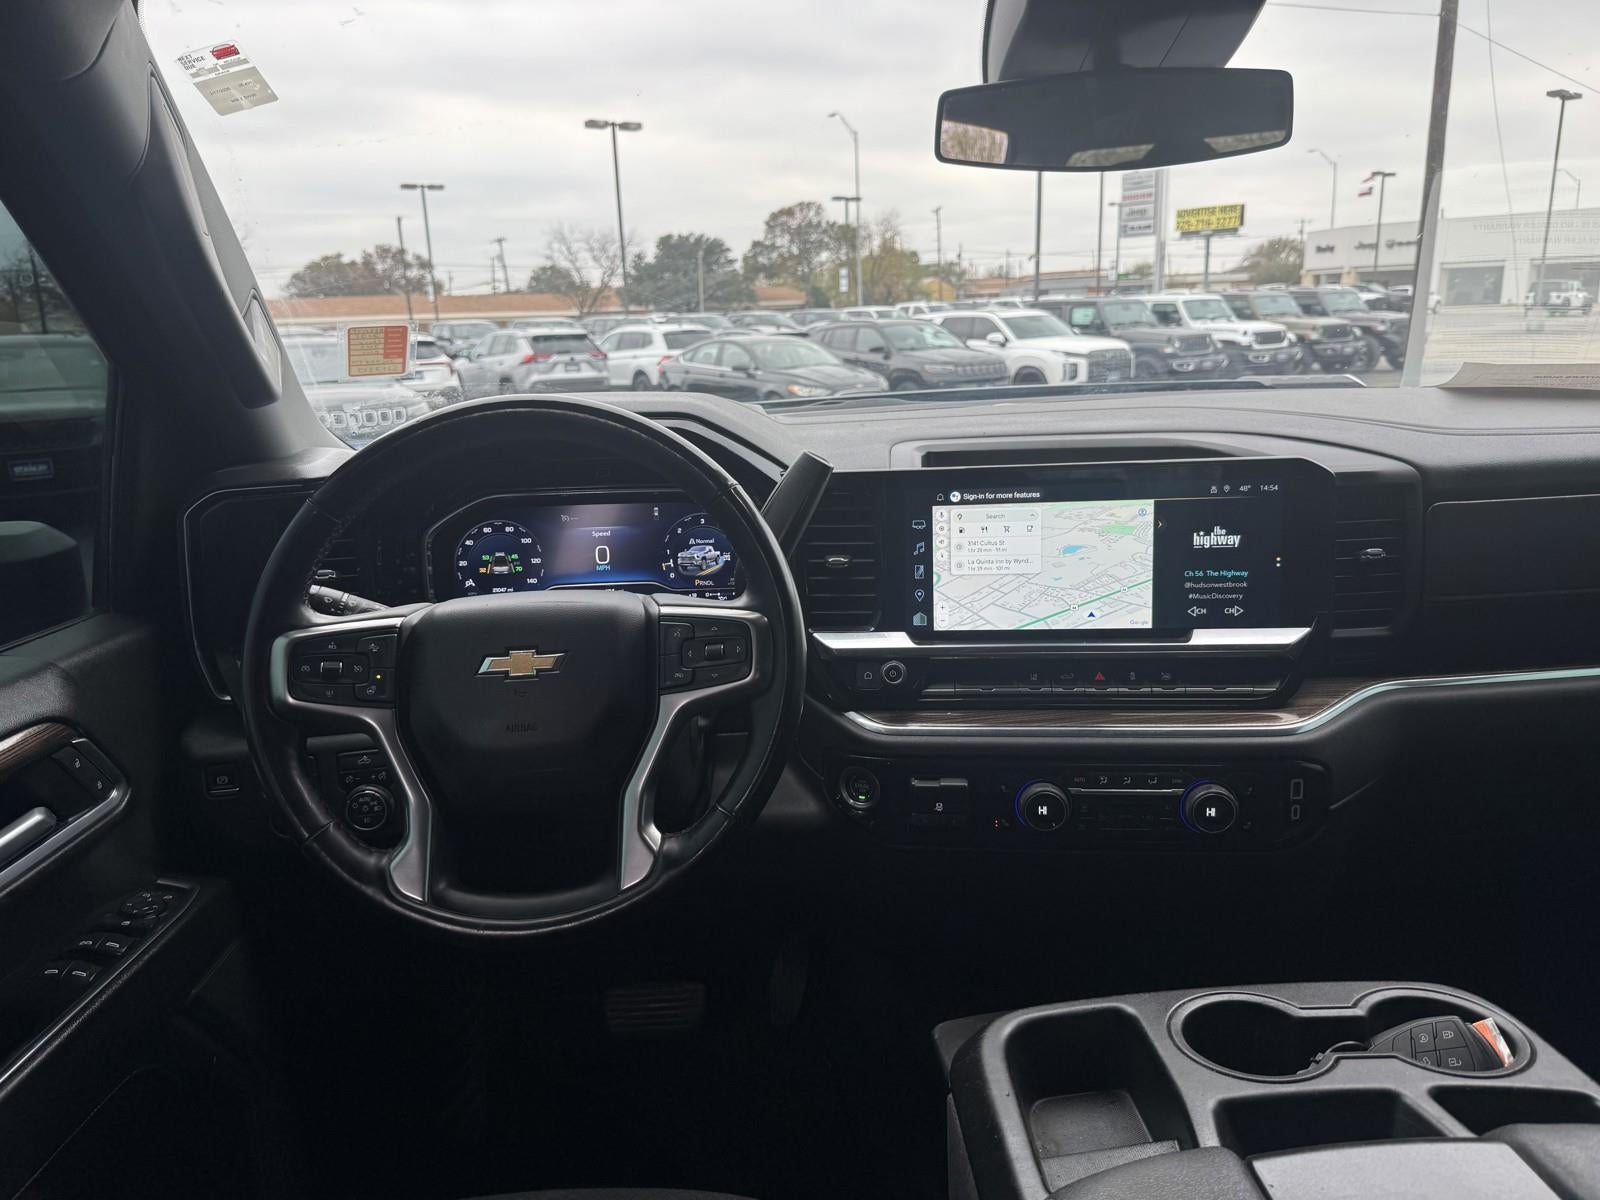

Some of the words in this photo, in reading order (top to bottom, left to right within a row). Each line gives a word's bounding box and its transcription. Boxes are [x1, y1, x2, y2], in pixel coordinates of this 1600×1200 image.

[180, 56, 205, 66] SERVICE
[963, 492, 984, 500] Sign-in
[1214, 526, 1226, 535] the
[1193, 531, 1241, 548] highway
[595, 546, 610, 564] 0
[1220, 570, 1248, 578] Highway
[1038, 806, 1048, 816] HI
[1206, 808, 1216, 818] HI
